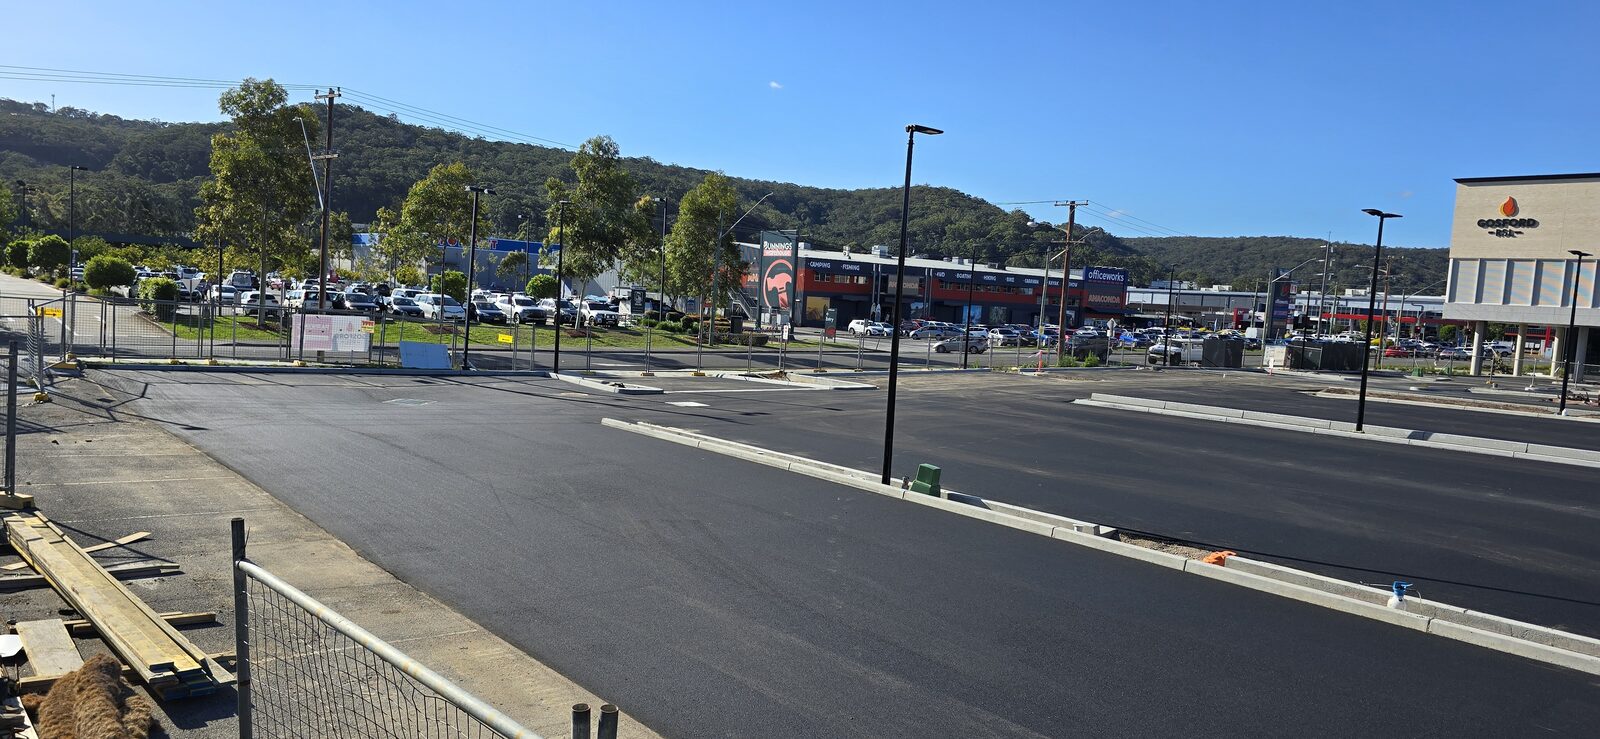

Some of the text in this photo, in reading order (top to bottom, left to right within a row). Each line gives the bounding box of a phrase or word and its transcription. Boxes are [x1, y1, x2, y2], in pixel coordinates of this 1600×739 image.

[1477, 218, 1539, 229] GOSFORD
[1495, 229, 1516, 238] RSL
[763, 241, 793, 250] BUNNINGS
[809, 261, 831, 269] CAMPING
[1088, 269, 1125, 282] officeworks
[1088, 294, 1121, 303] ANACONDA
